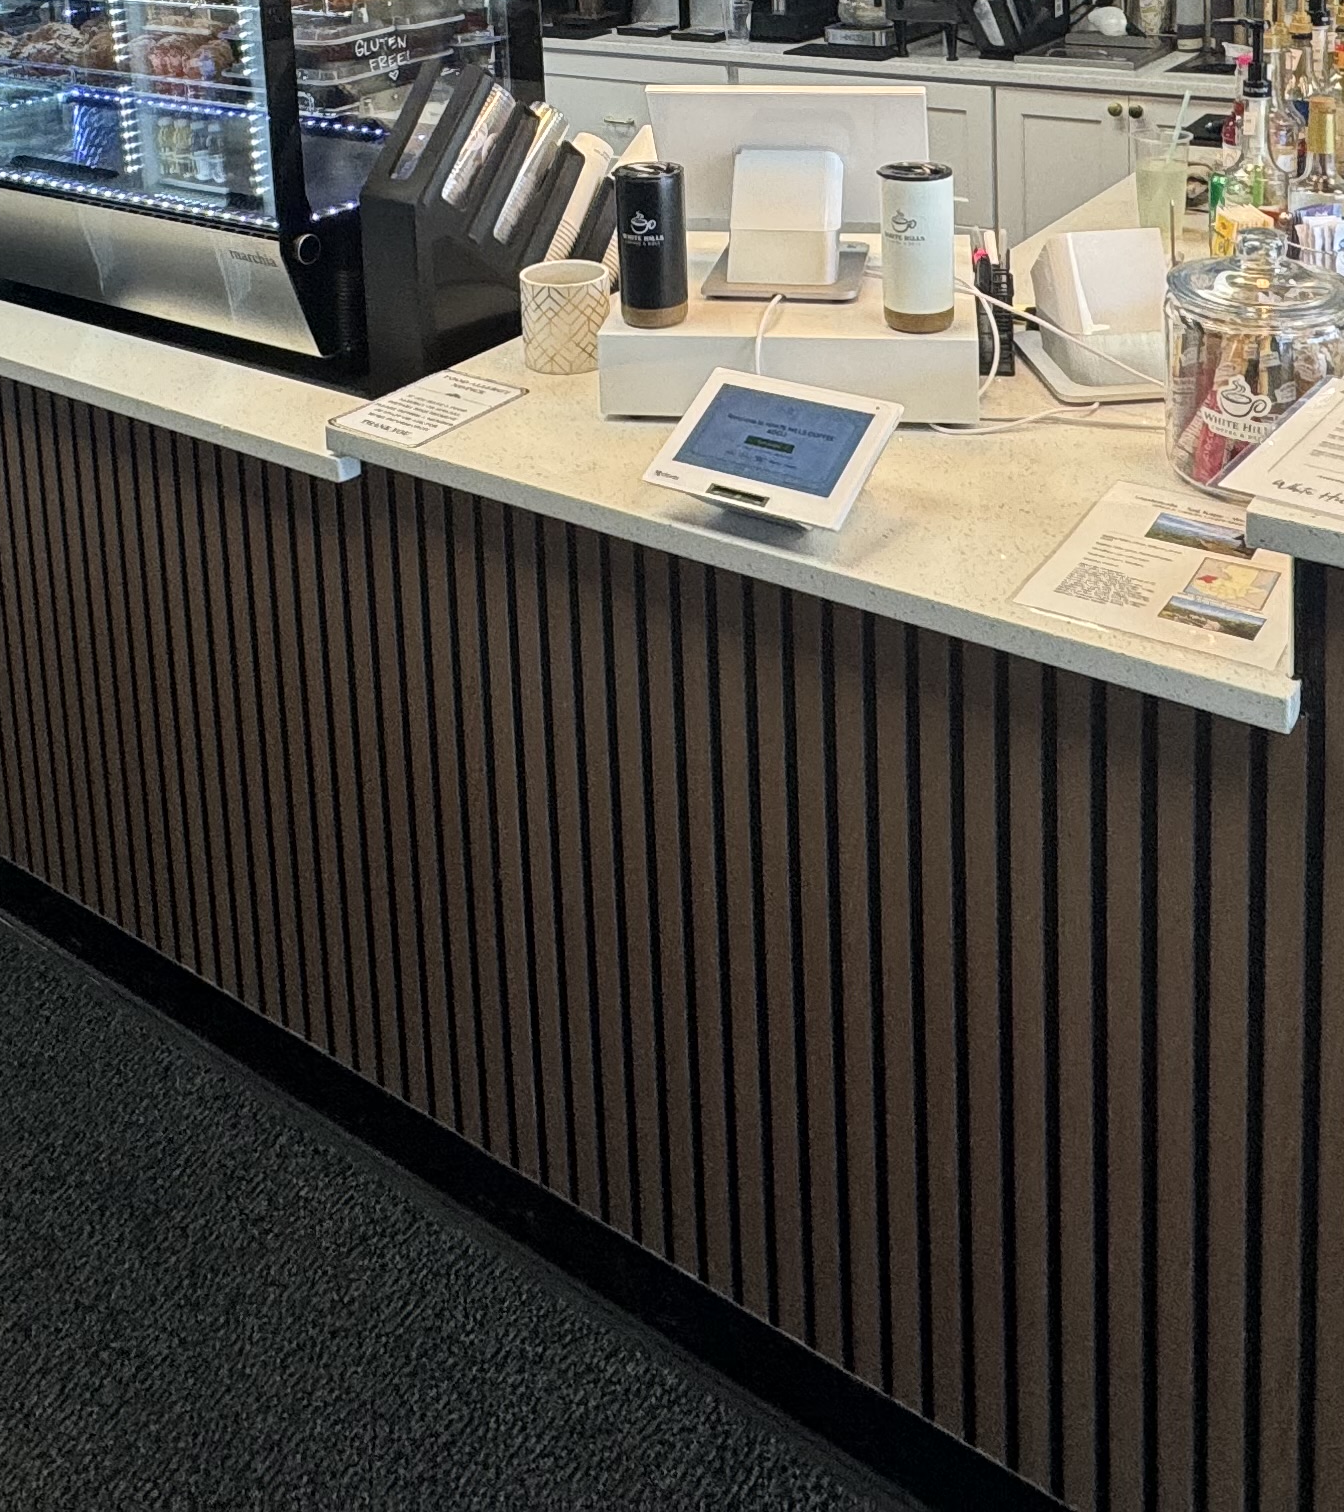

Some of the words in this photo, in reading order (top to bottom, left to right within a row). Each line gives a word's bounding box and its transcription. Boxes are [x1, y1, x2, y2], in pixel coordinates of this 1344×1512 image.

[355, 34, 407, 57] GLUTEN
[369, 49, 410, 72] FREE!
[1204, 411, 1239, 430] WHITE
